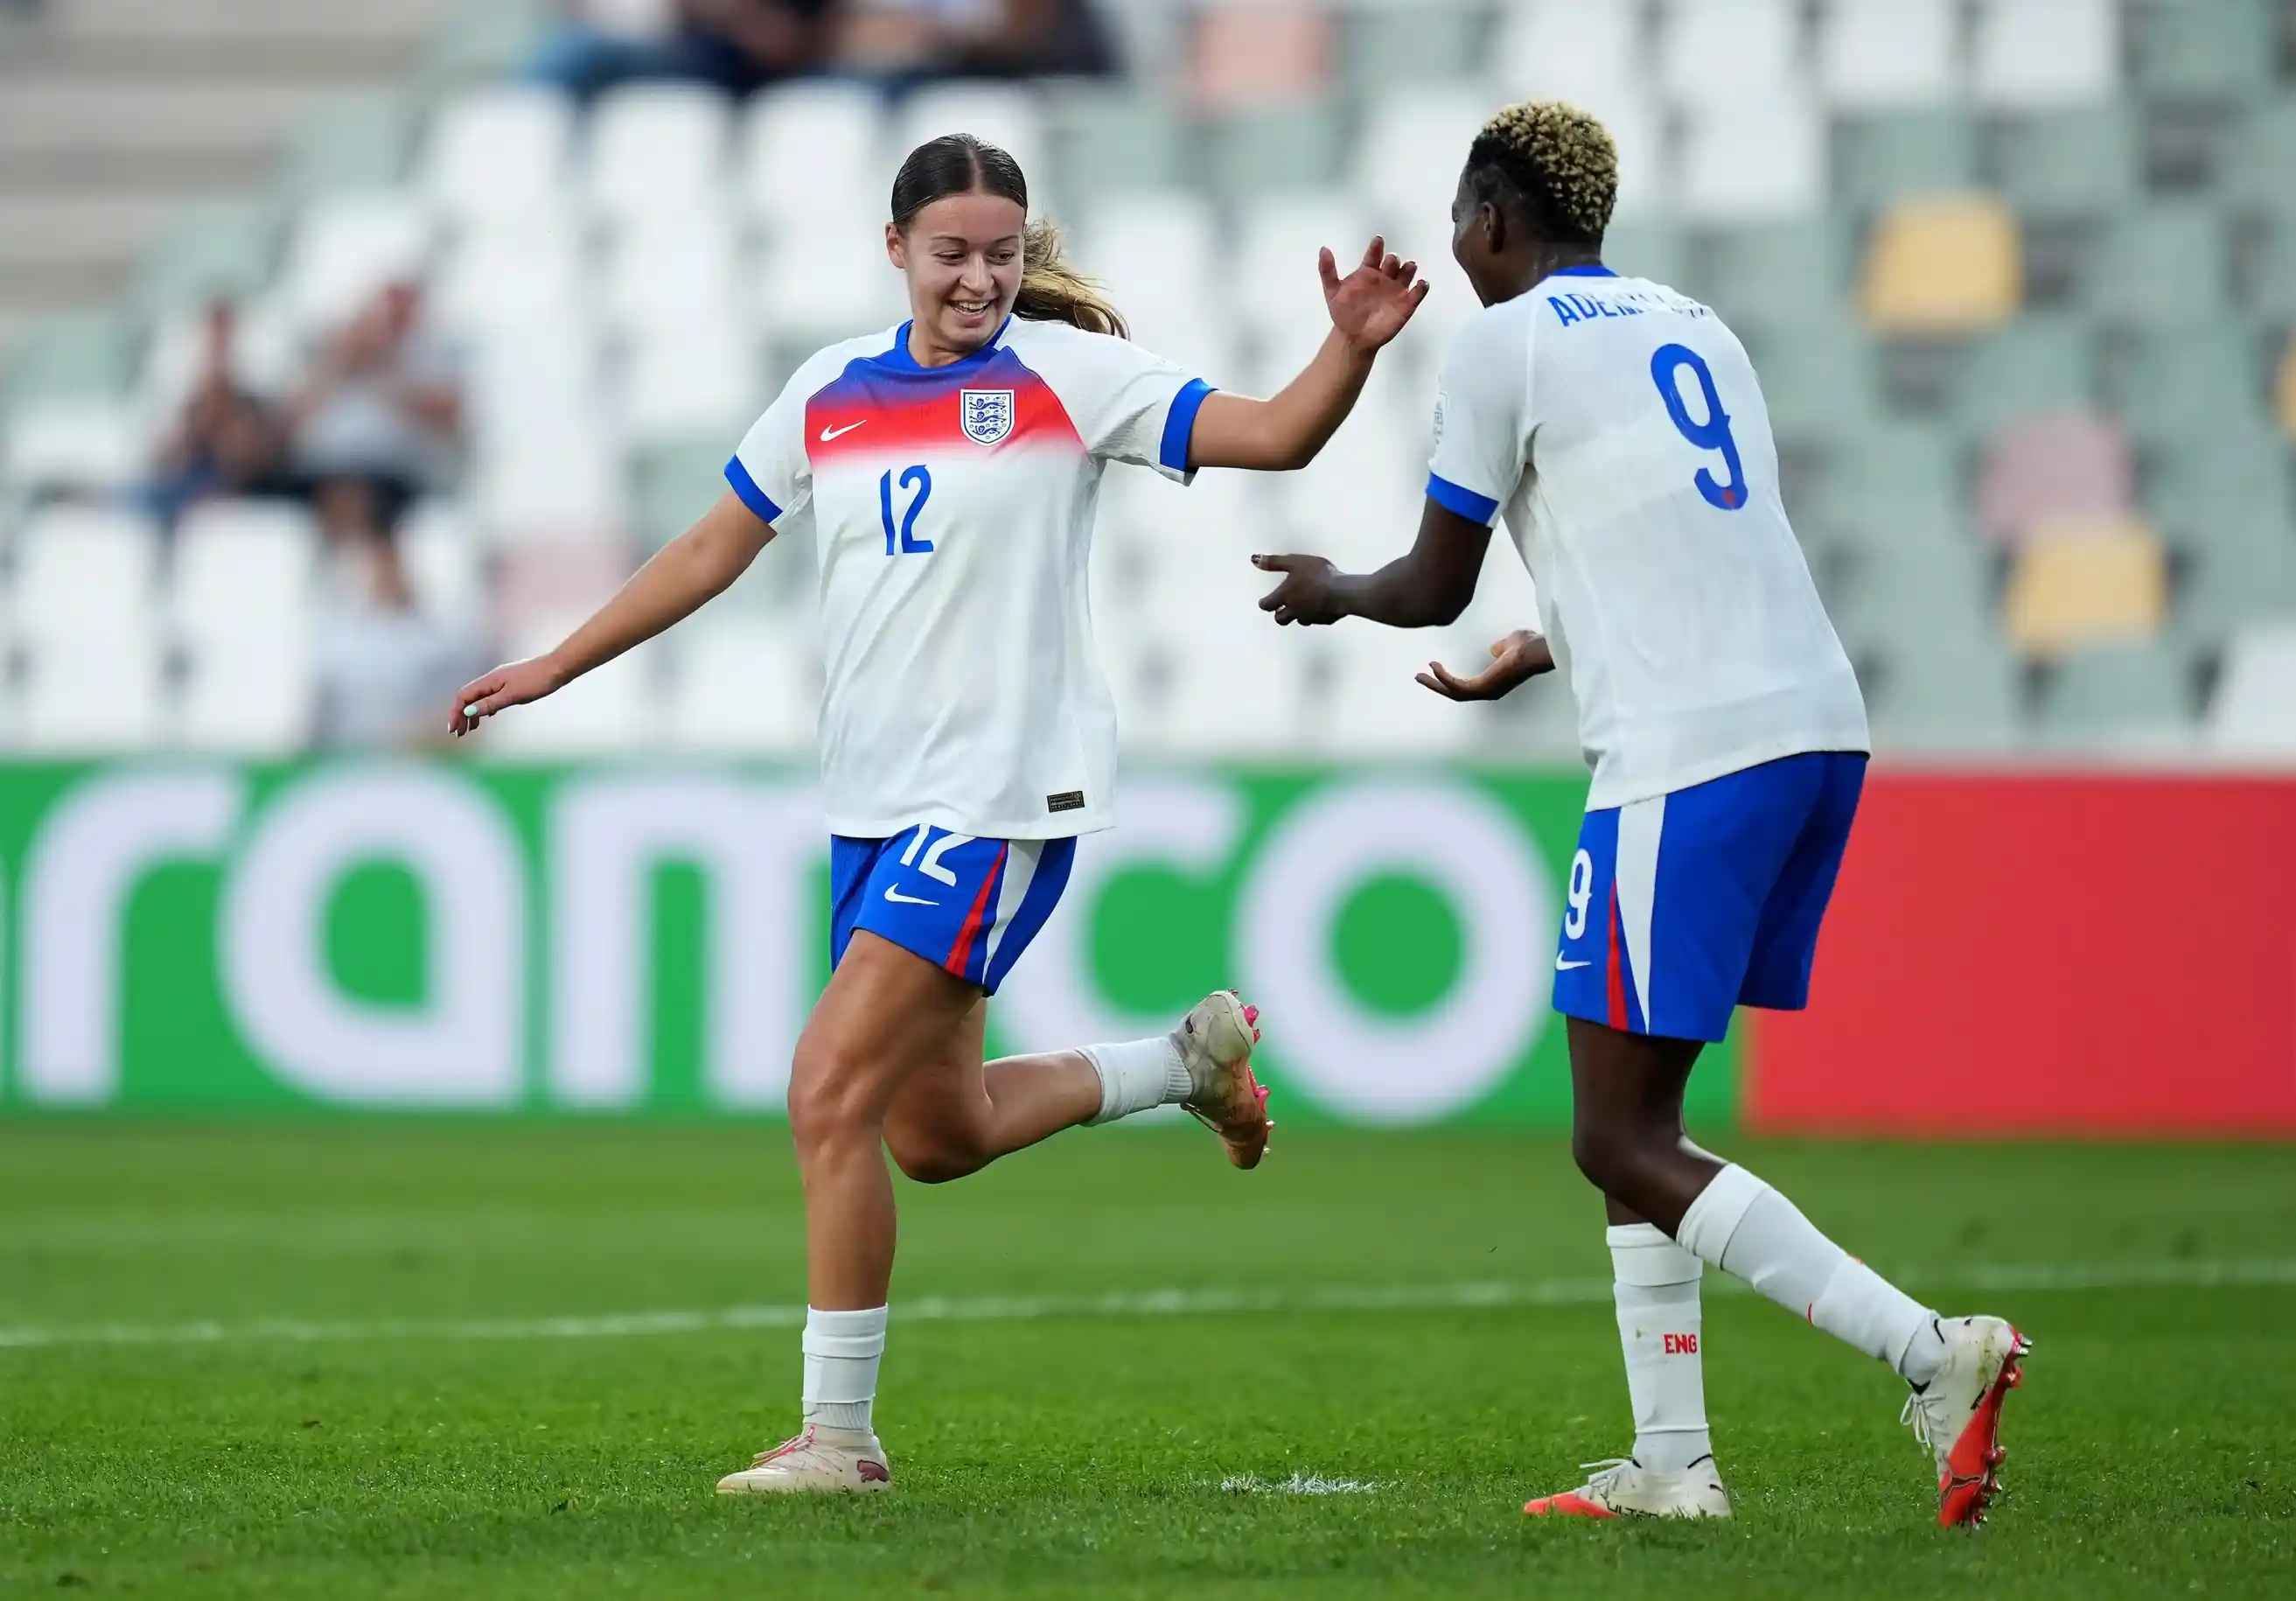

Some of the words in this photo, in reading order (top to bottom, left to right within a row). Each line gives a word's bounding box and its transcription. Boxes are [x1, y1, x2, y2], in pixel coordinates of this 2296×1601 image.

[1650, 343, 1748, 511] 9
[880, 465, 934, 556] 12
[1565, 848, 1593, 940] 9
[1663, 1333, 1698, 1354] ENG
